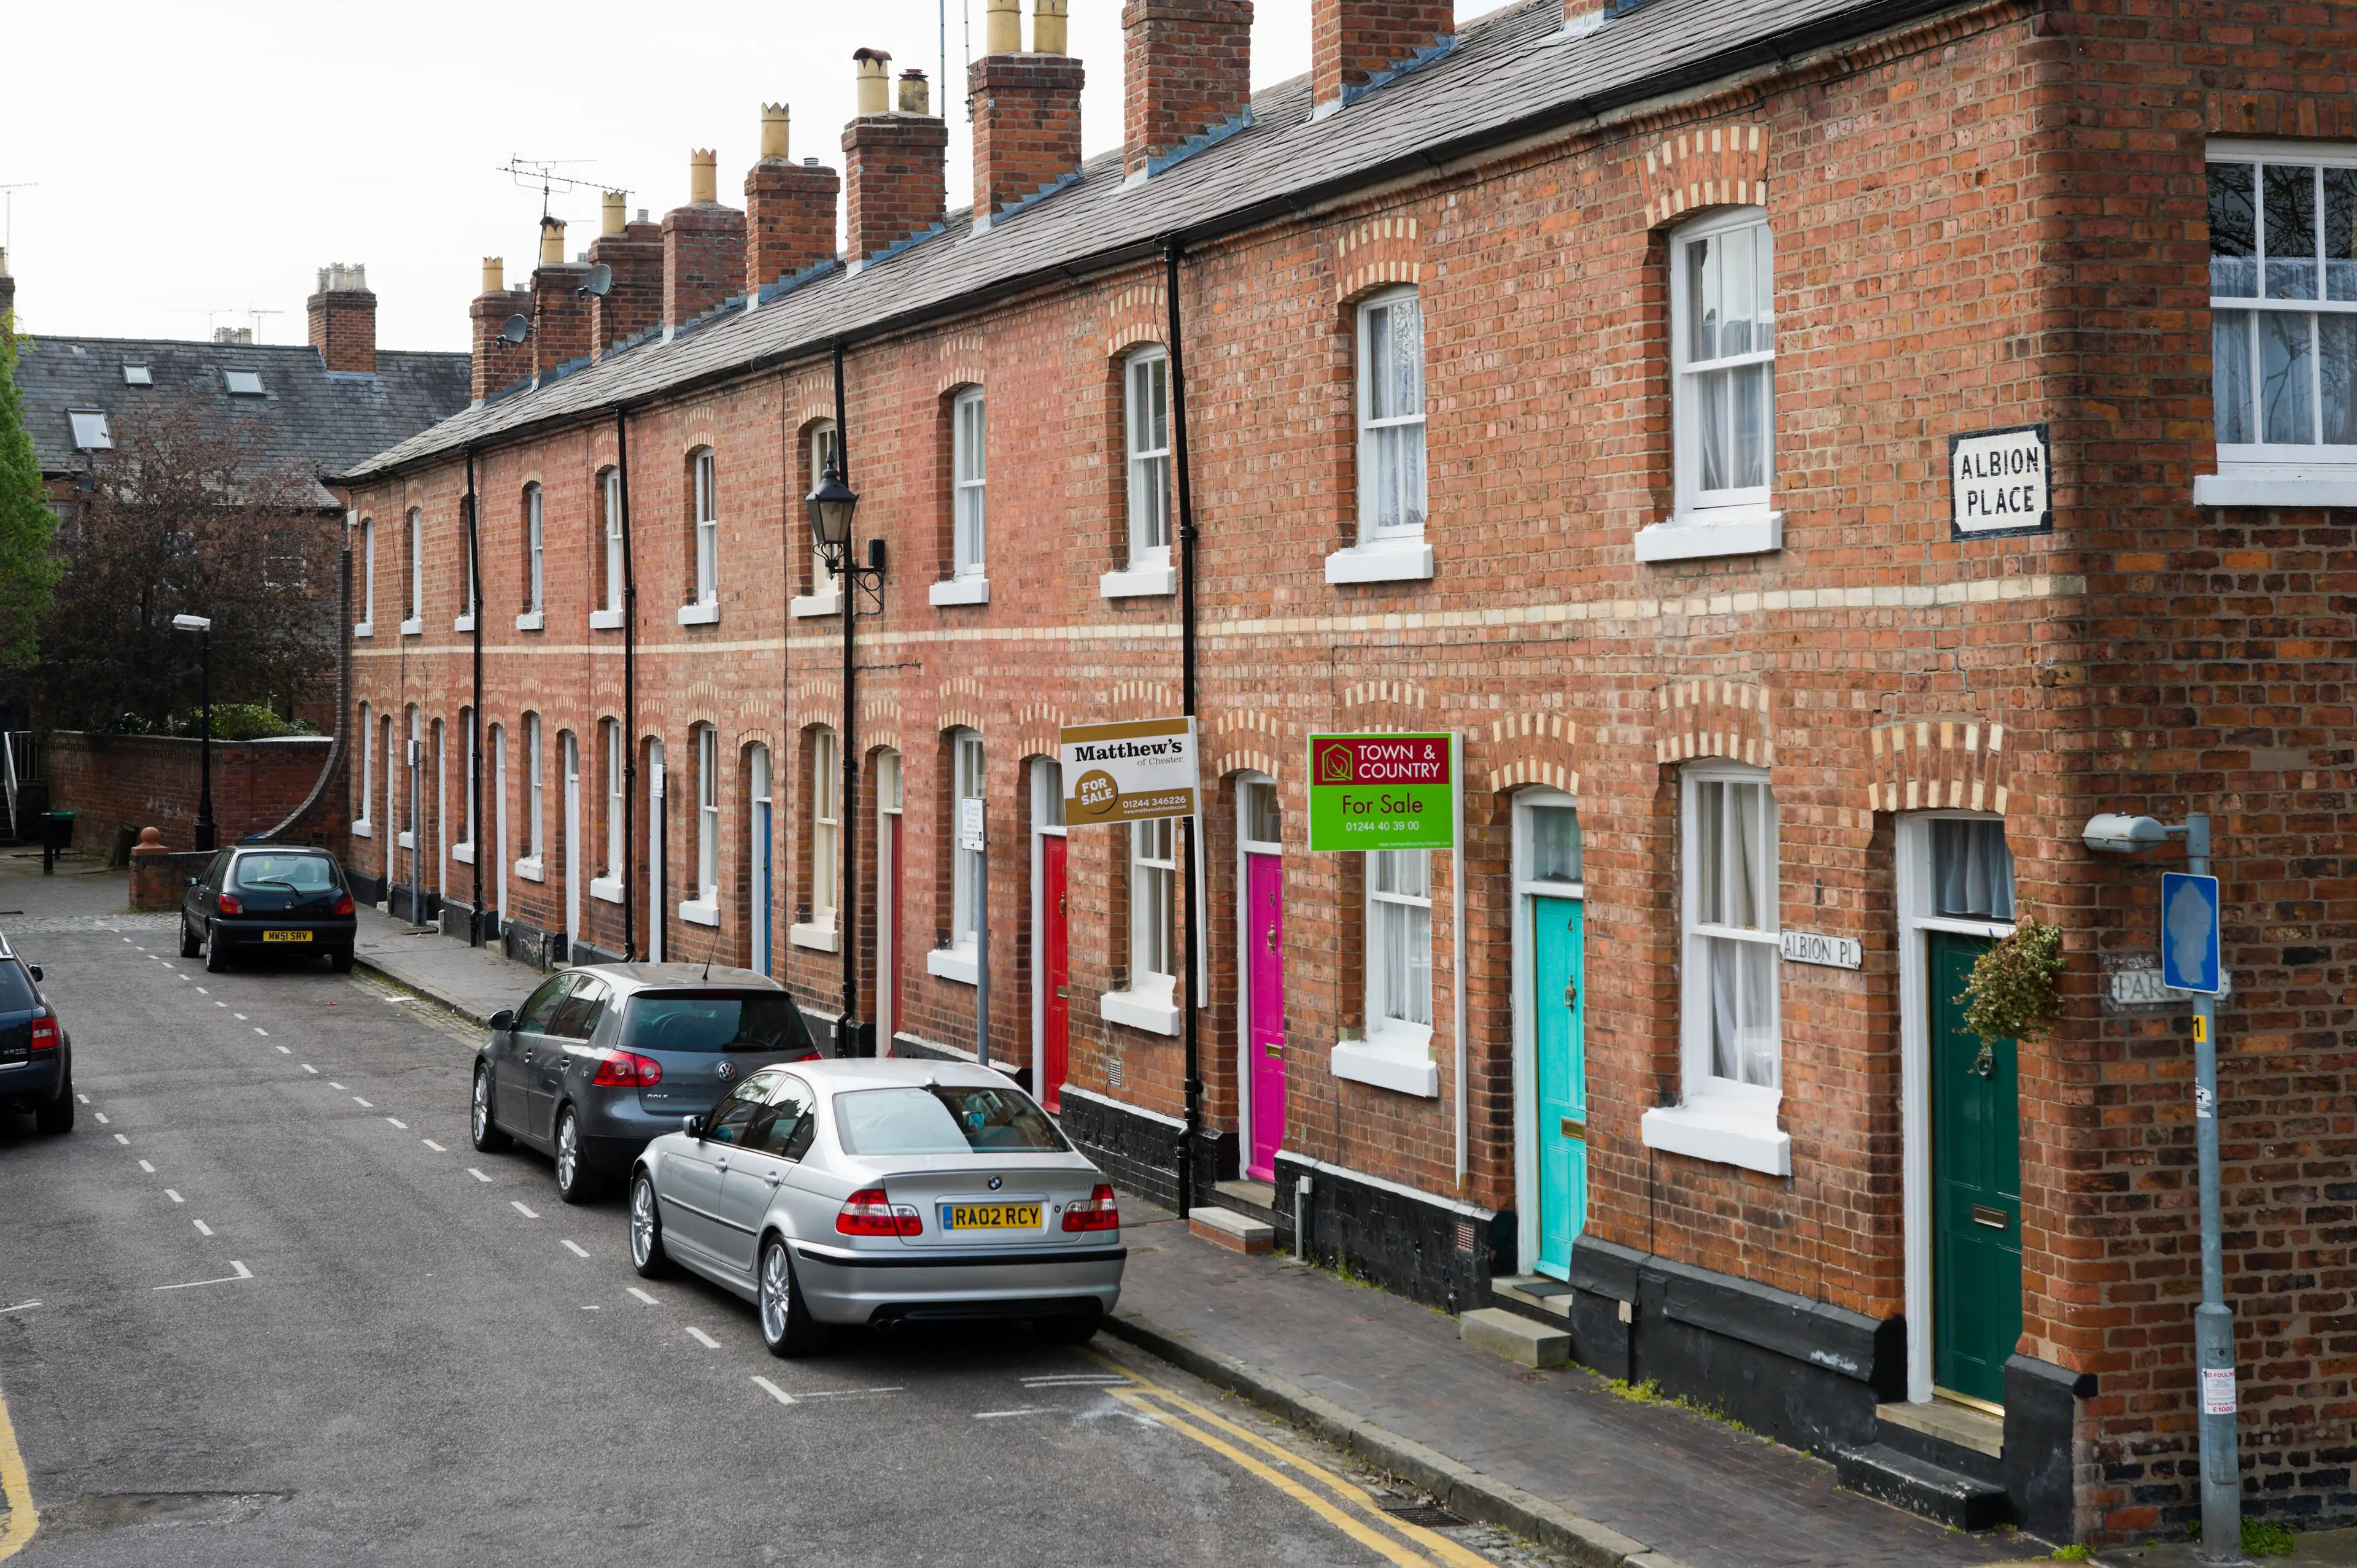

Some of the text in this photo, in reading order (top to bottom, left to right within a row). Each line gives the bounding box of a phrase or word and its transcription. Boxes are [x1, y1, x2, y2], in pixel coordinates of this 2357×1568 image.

[1961, 447, 2038, 480] ALBION
[1967, 485, 2034, 516] PLACE
[1075, 738, 1182, 762] Matthew's
[1358, 744, 1436, 760] TOWN &
[1148, 756, 1183, 765] Chester
[1359, 762, 1440, 778] COUNTRY
[1082, 778, 1107, 794] FOR
[1081, 787, 1114, 805] SALE
[1123, 795, 1186, 808] 01244 346226
[1342, 792, 1423, 814] For Sale
[1345, 821, 1420, 831] 01244 40 39 00
[268, 932, 307, 940] MW51 SRV
[1784, 935, 1831, 960] ALBION
[2193, 1017, 2200, 1037] 1
[955, 1207, 1039, 1226] RA02 RCY
